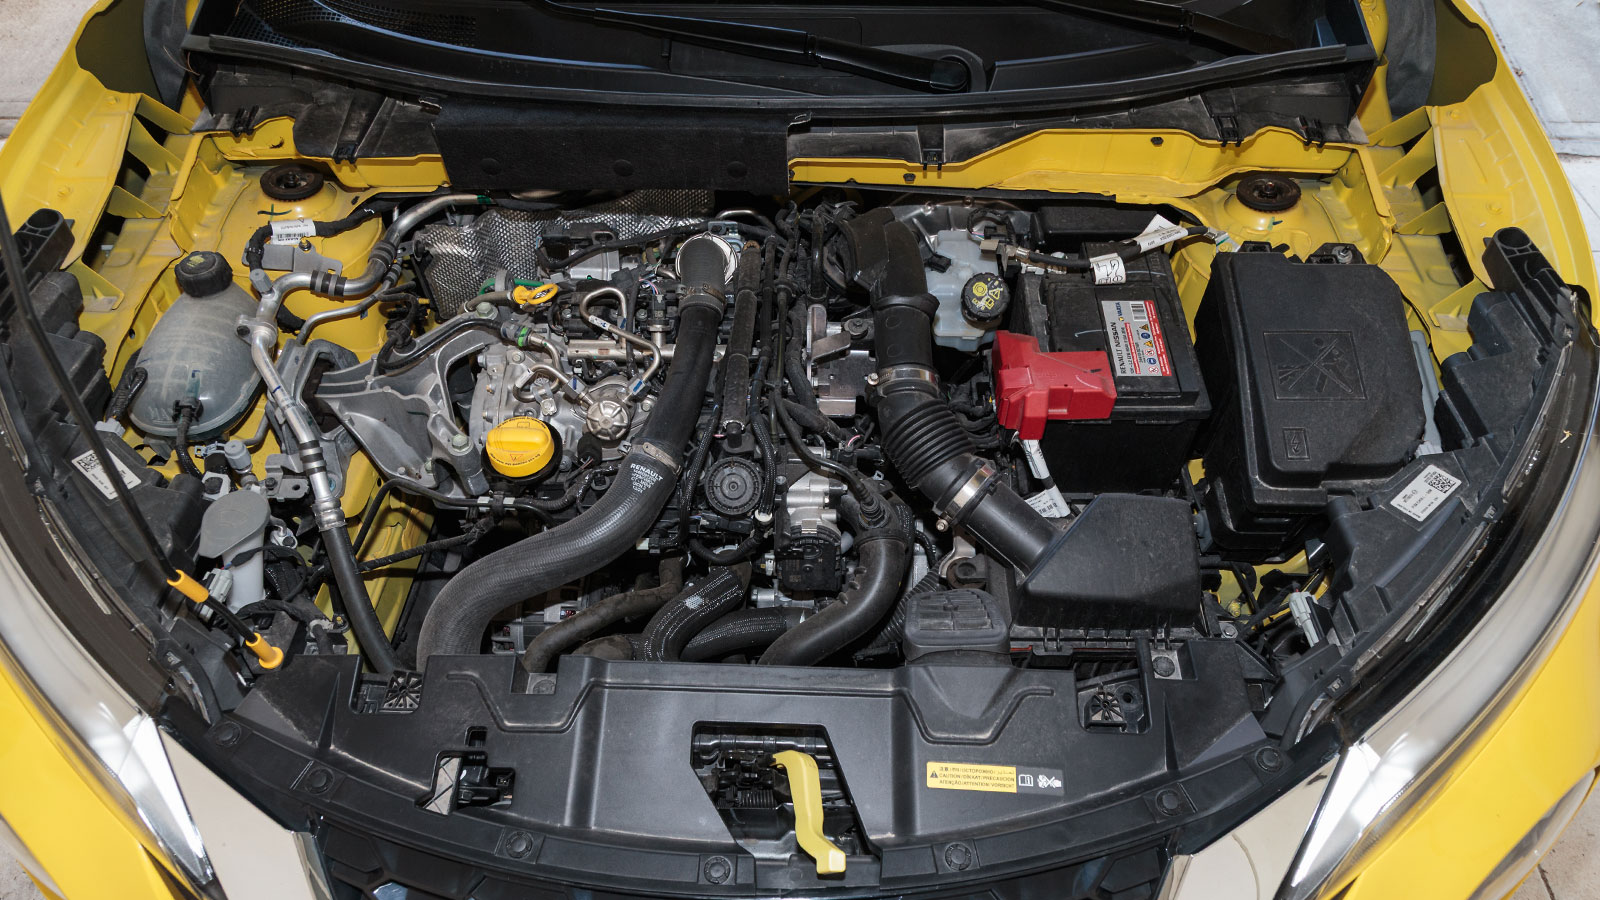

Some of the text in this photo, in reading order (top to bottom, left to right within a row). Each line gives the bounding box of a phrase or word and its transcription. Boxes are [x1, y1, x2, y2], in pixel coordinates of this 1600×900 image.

[1110, 321, 1120, 347] NISSAN
[1116, 349, 1126, 374] RENAULT
[630, 463, 663, 481] RENAULT
